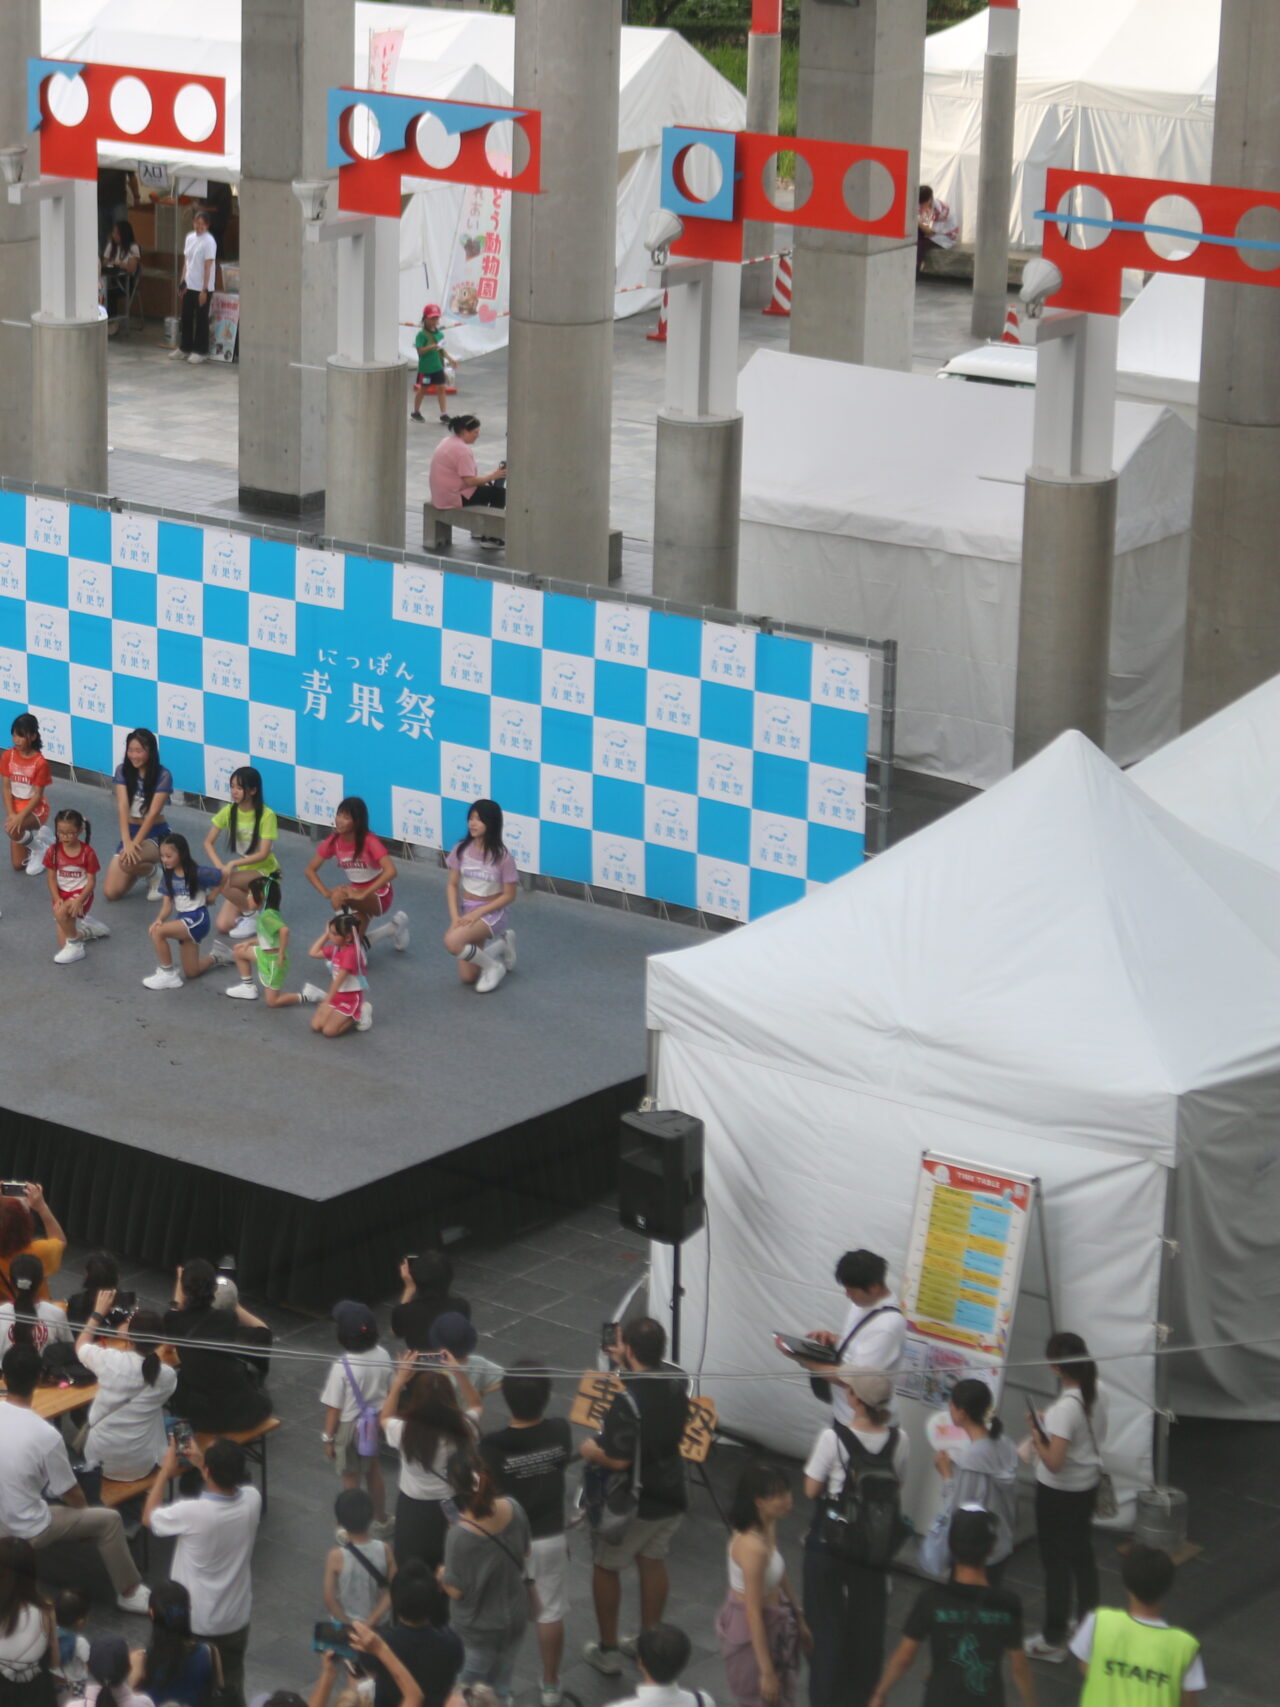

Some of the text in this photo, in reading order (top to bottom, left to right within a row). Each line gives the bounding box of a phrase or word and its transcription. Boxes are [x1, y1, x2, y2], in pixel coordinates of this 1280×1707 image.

[142, 164, 163, 178] 入口
[317, 647, 414, 681] にっぽん
[301, 668, 437, 741] 青果祭
[956, 1172, 1001, 1189] TIME TABLE
[1103, 1660, 1170, 1688] STAFF
